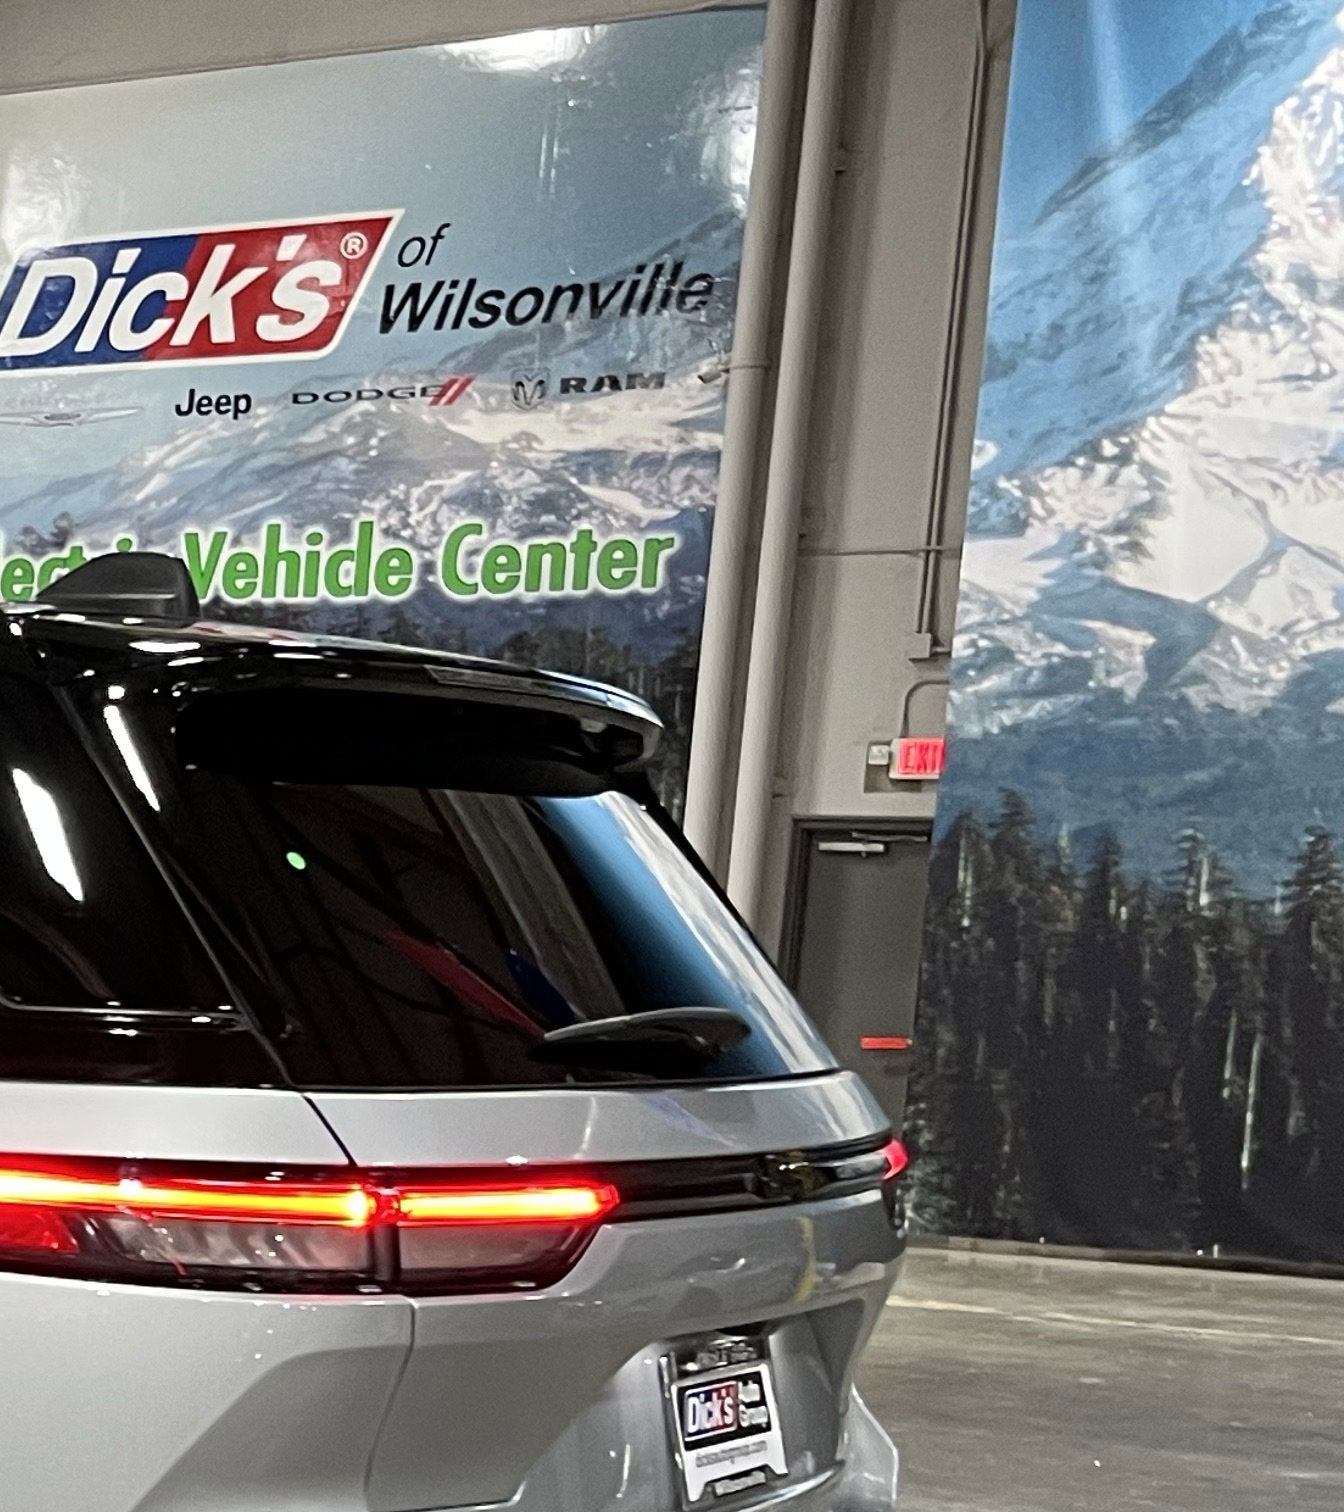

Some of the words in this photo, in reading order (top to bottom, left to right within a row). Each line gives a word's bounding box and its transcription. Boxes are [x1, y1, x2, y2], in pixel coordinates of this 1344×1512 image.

[397, 222, 451, 268] of
[378, 259, 717, 334] Wilsonville
[174, 387, 253, 420] Jeep
[291, 384, 447, 405] DODGE
[559, 371, 666, 395] RAM
[184, 521, 414, 600] Vehicle
[441, 523, 675, 596] Center
[686, 1387, 735, 1434] Dick's
